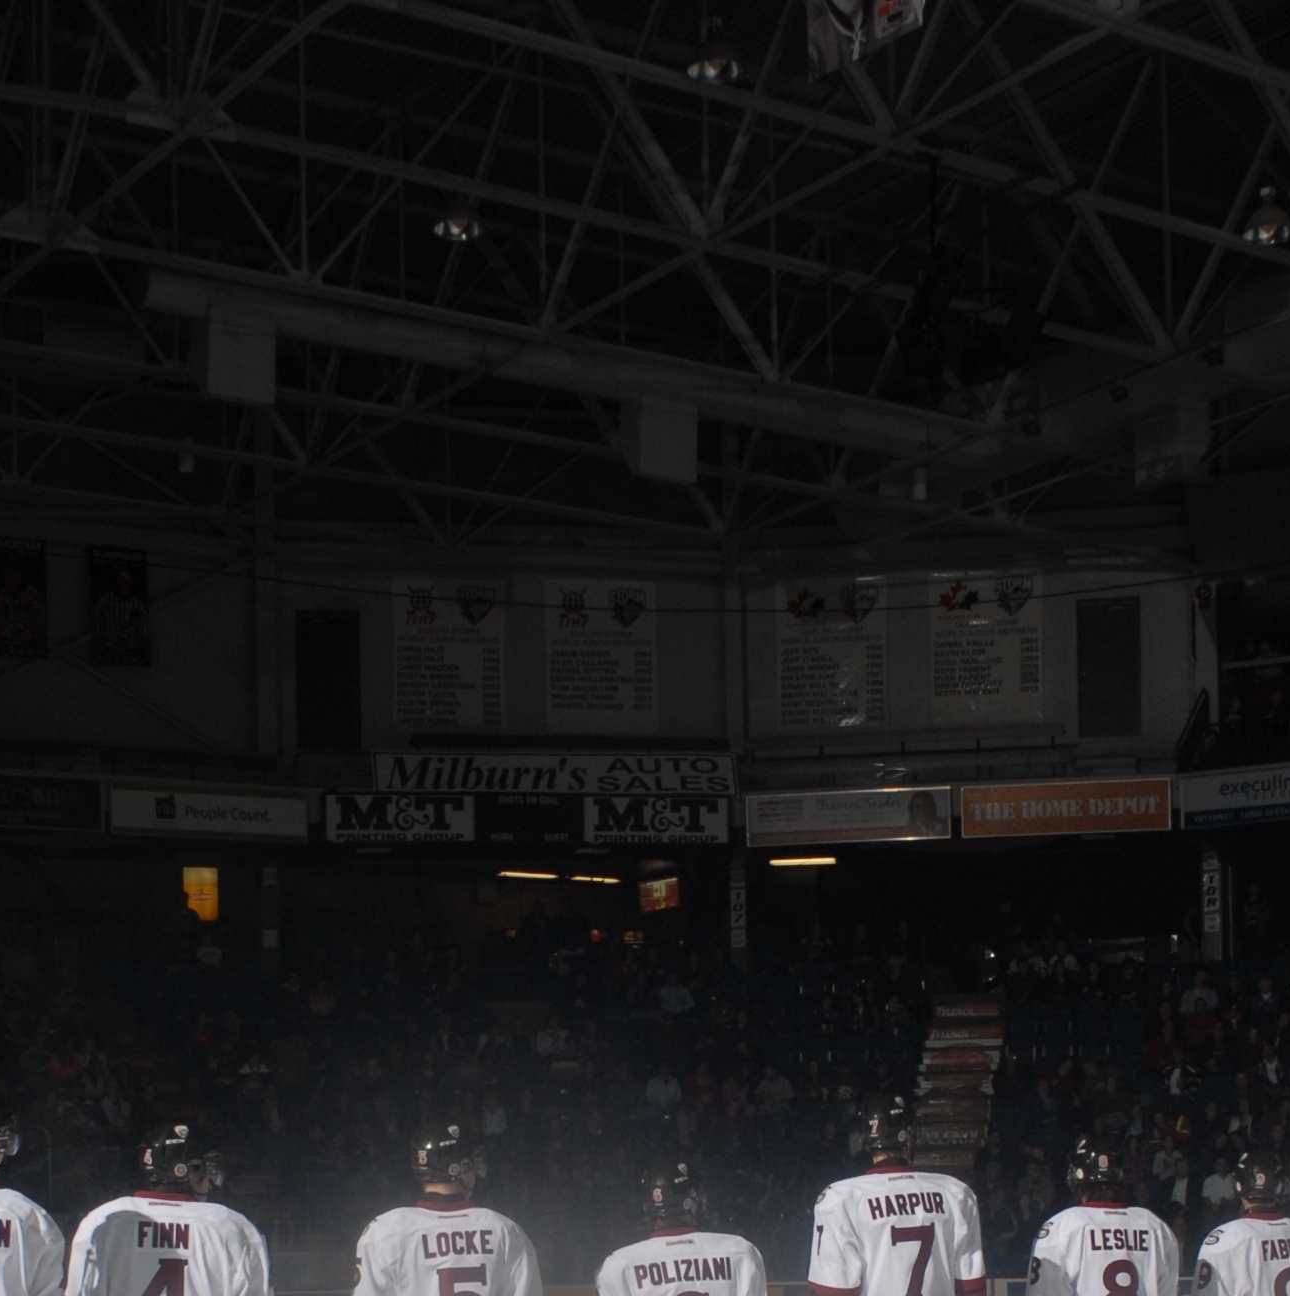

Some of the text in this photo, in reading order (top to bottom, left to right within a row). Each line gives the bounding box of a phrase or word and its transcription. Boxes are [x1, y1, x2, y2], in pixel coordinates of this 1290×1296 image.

[386, 756, 719, 791] Milburn's AUTO
[596, 775, 731, 793] SALES
[185, 804, 228, 821] People
[336, 795, 464, 831] M&T
[498, 795, 559, 806] SHOTS ON GOAL
[971, 796, 1159, 821] THE HOME DEPOT
[594, 797, 719, 833] M&T
[1194, 812, 1233, 823] INTERNET
[1240, 808, 1263, 820] LONG
[336, 832, 465, 842] PRINTING GROUP
[491, 832, 569, 843] HOME GUEST
[594, 834, 719, 844] PRINTING GROUP
[868, 1191, 946, 1221] HARPUR
[137, 1221, 190, 1250] FINN
[422, 1229, 495, 1260] LOCKE
[1089, 1227, 1151, 1252] LESLIE
[634, 1256, 733, 1291] POLIZIANI
[1197, 1258, 1212, 1290] 9
